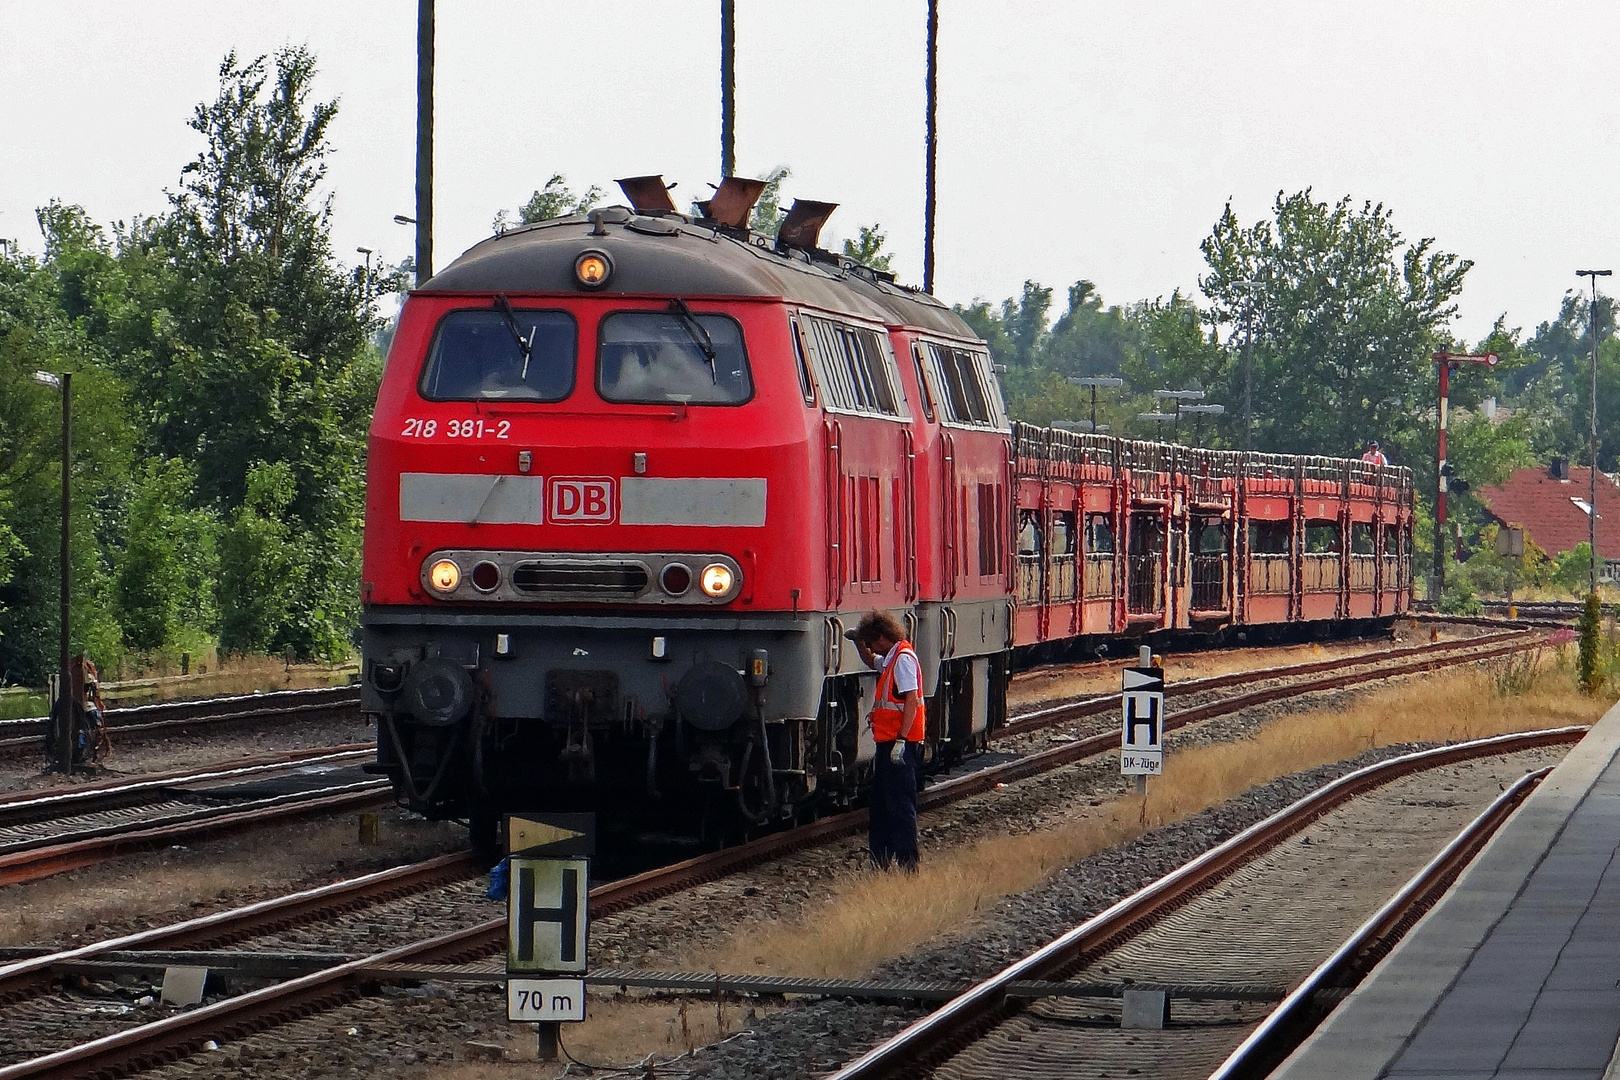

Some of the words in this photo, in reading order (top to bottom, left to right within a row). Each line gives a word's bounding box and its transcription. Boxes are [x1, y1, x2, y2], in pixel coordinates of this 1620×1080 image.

[401, 418, 438, 438] 218
[446, 419, 511, 439] 381-2
[556, 484, 608, 516] DB
[1126, 696, 1159, 746] H
[517, 867, 578, 962] H
[517, 990, 543, 1011] 70
[552, 995, 572, 1011] m
